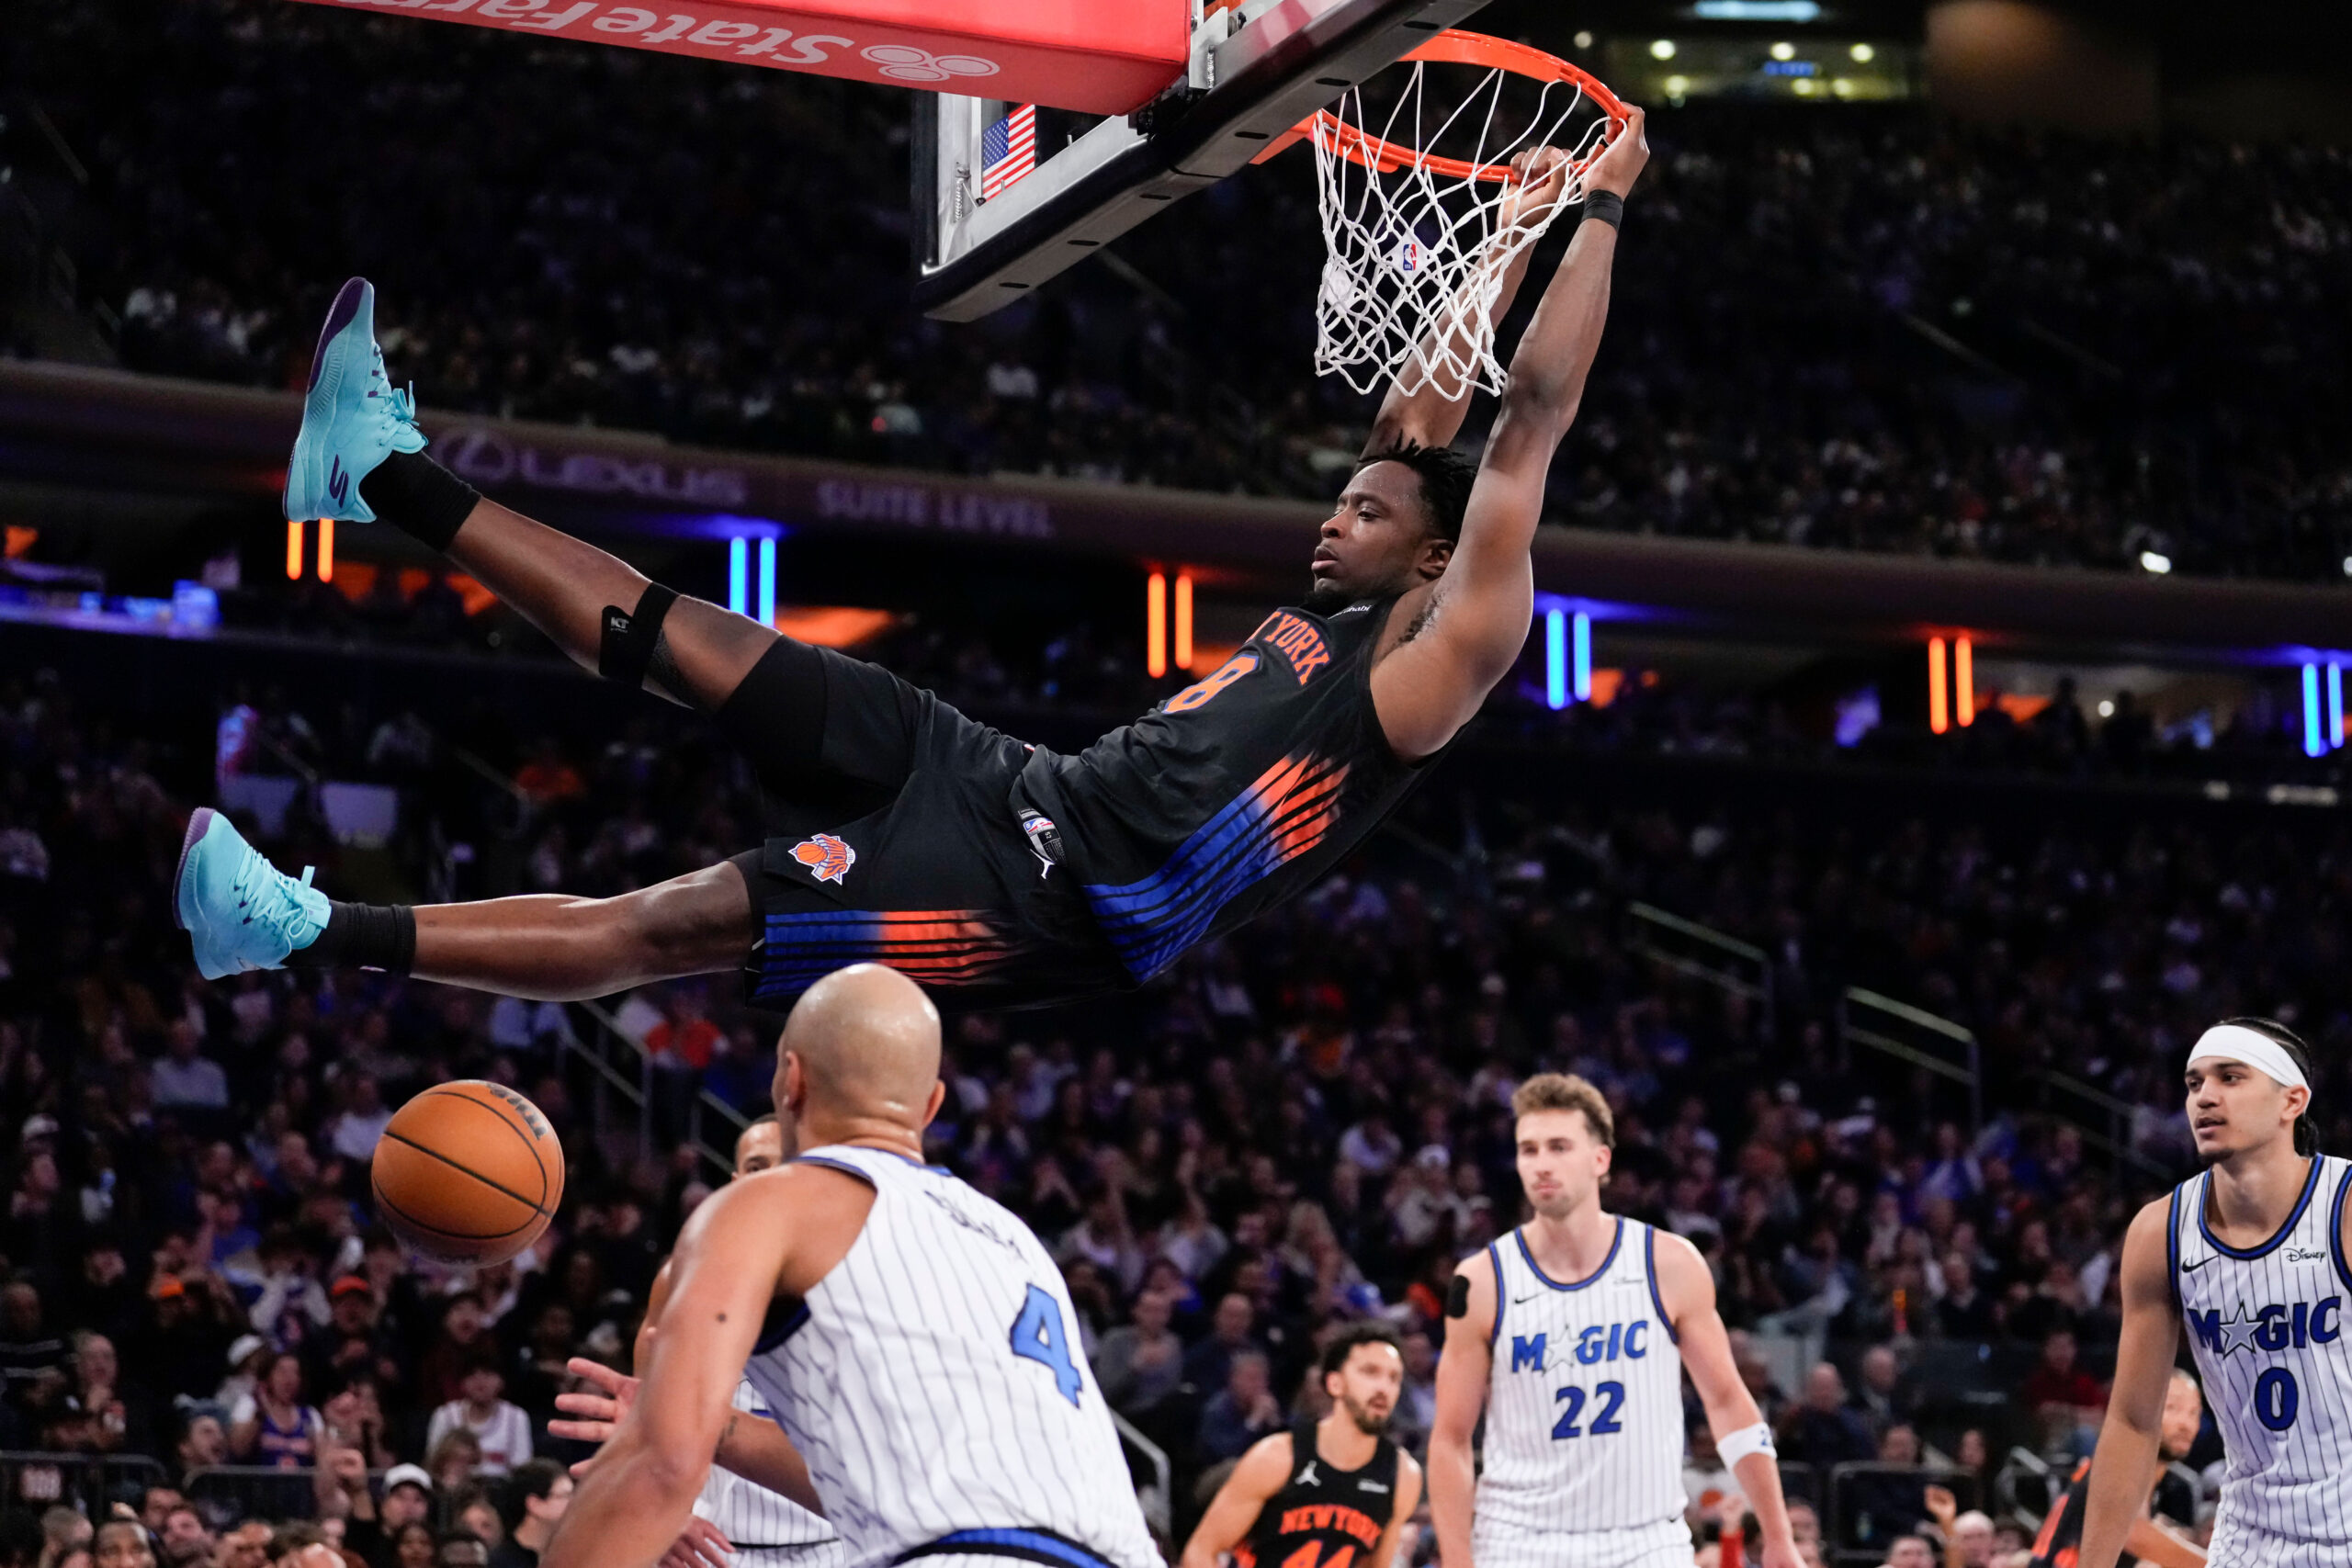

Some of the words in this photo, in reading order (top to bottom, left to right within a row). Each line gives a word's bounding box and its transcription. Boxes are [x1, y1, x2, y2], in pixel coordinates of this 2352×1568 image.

[588, 6, 855, 64] State
[519, 453, 746, 505] LEXUS
[1262, 613, 1331, 686] YORK
[1160, 653, 1260, 714] 8
[1009, 1281, 1083, 1410] 4
[1551, 1381, 1625, 1440] 22
[2254, 1367, 2299, 1431] 0
